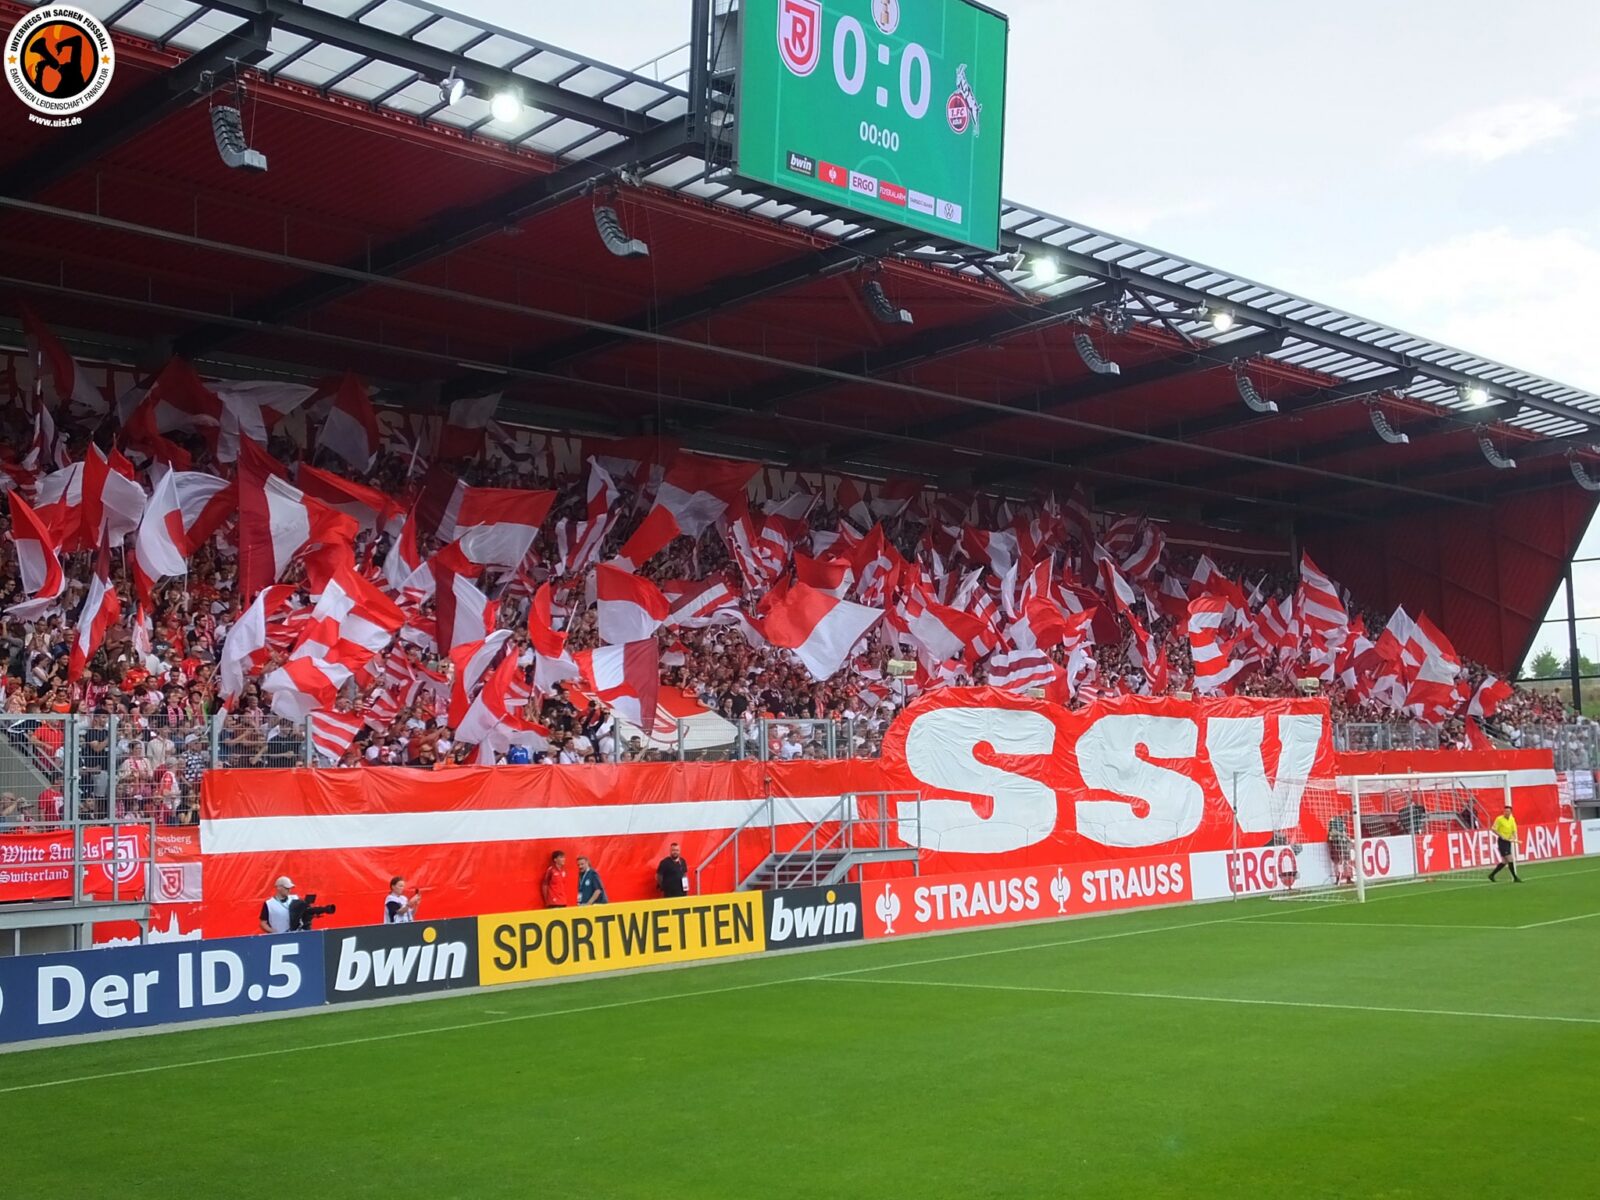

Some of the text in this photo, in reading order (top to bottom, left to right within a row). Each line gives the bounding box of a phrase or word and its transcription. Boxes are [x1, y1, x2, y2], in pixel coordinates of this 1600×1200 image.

[833, 15, 931, 119] 0:0
[859, 121, 899, 151] 00:00
[790, 153, 812, 171] bwin
[852, 176, 874, 192] ERGO
[897, 707, 1323, 853] SSV
[1, 842, 99, 865] White Anels
[1448, 825, 1562, 869] FLYERLARM
[0, 869, 69, 883] Switzerland
[1081, 862, 1185, 903] STRAUSS
[1226, 848, 1297, 893] ERGO
[770, 890, 857, 943] bwin
[914, 875, 1040, 923] STRAUSS
[335, 926, 468, 992] bwin
[493, 901, 755, 972] SPORTWETTEN
[38, 943, 301, 1025] Der ID.5
